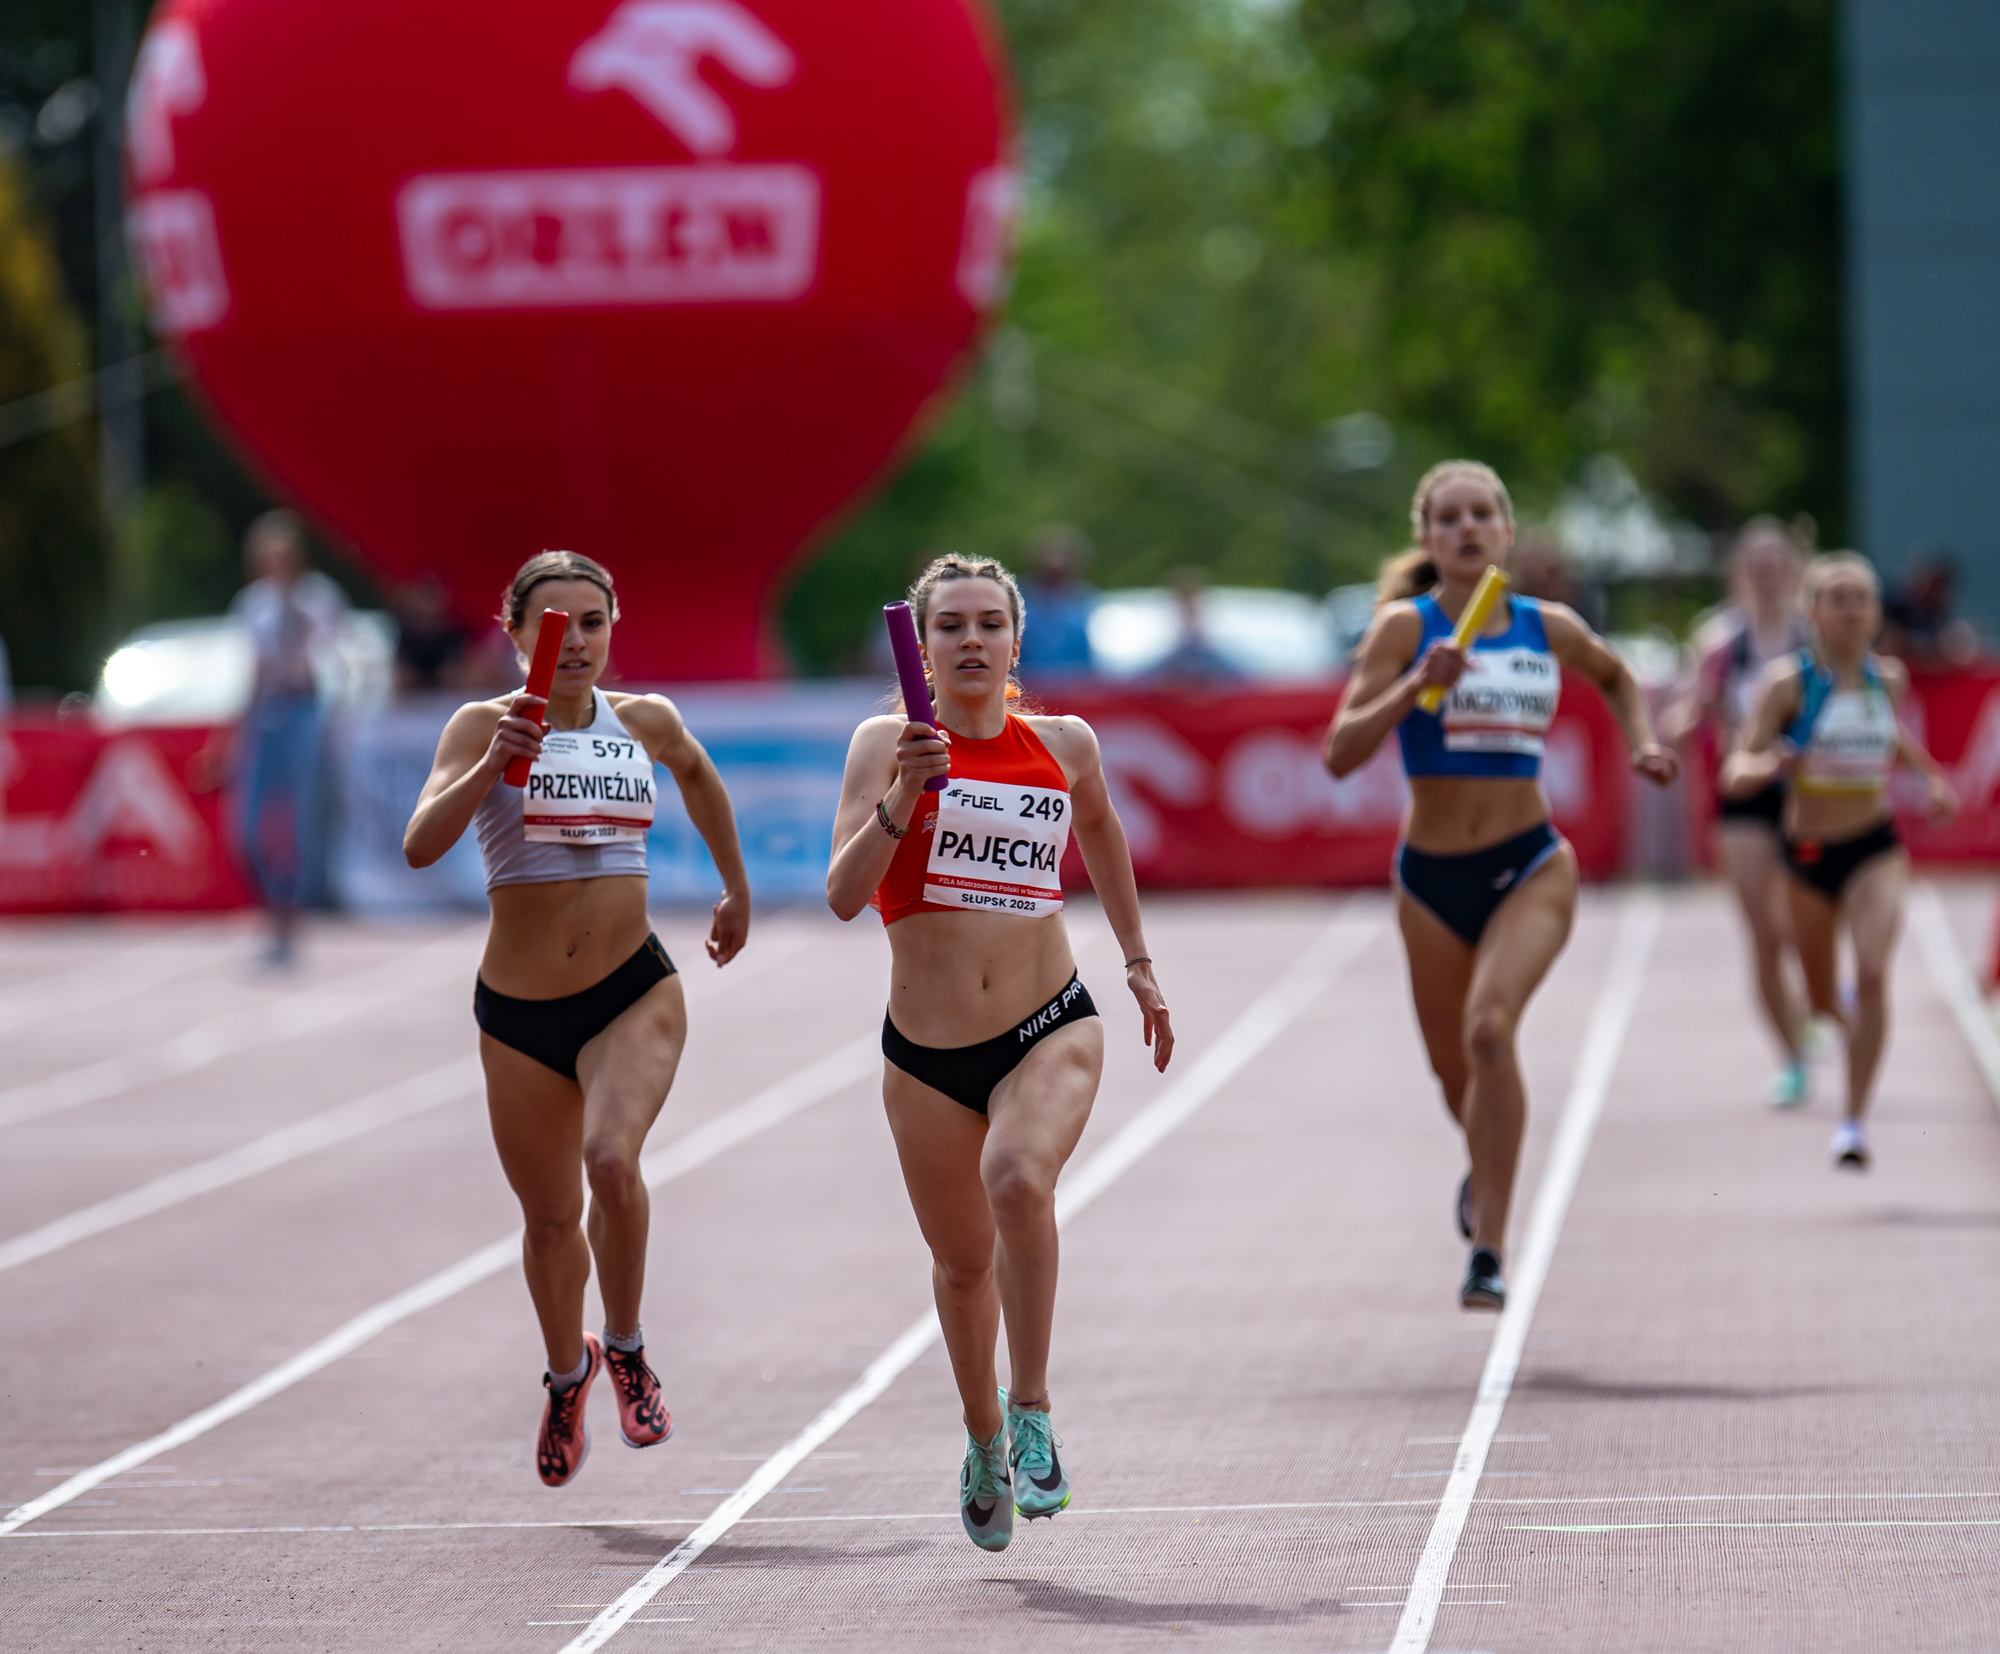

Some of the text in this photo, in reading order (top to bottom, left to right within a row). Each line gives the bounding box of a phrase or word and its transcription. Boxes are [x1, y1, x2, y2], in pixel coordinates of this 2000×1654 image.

[438, 204, 781, 275] ORLEN
[592, 739, 635, 759] 597
[529, 771, 653, 804] PRZEWIEŹLIK
[960, 793, 1005, 811] FUEL
[1018, 793, 1065, 822] 249
[937, 831, 1056, 873] PAJĘCKA
[938, 876, 956, 886] PZLA
[956, 879, 998, 891] Mistrzostwa
[998, 884, 1020, 894] Polski
[961, 893, 1036, 911] SŁUPSK 2023
[1018, 1000, 1062, 1043] NIKE
